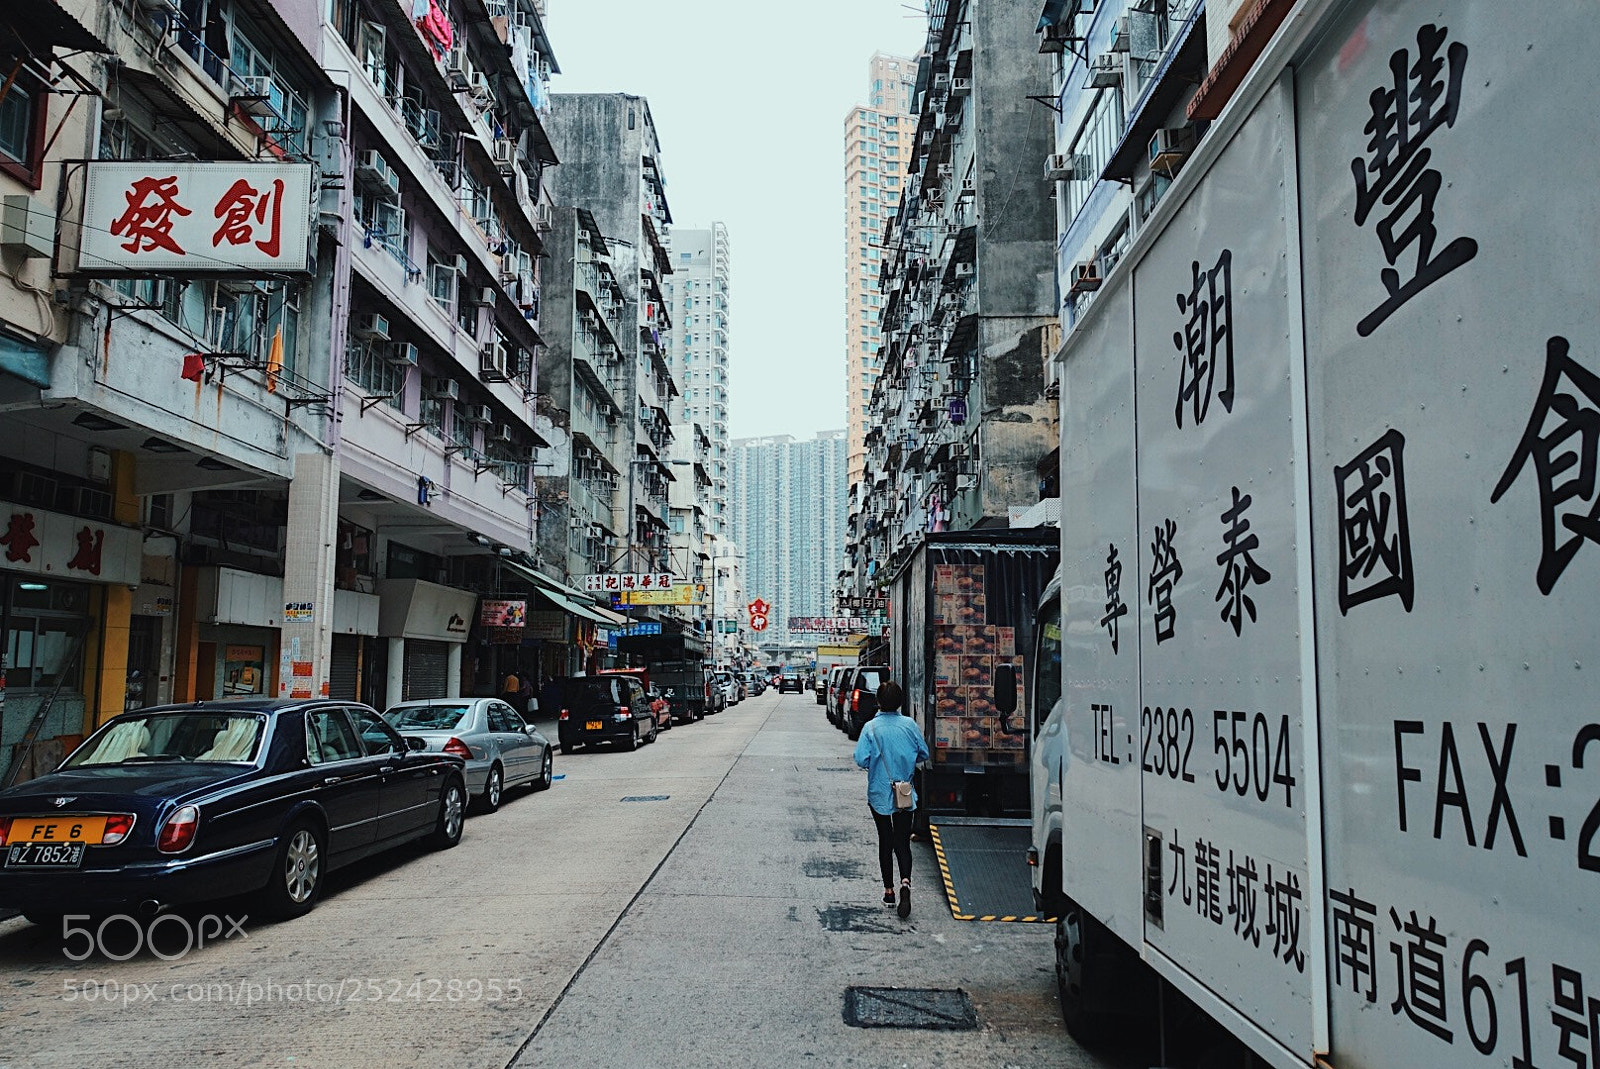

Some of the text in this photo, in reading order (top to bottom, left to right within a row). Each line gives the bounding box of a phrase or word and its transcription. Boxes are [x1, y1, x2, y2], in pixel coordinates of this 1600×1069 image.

[1142, 706, 1195, 783] 2382
[1213, 710, 1296, 808] 5504
[31, 824, 83, 839] FE 6
